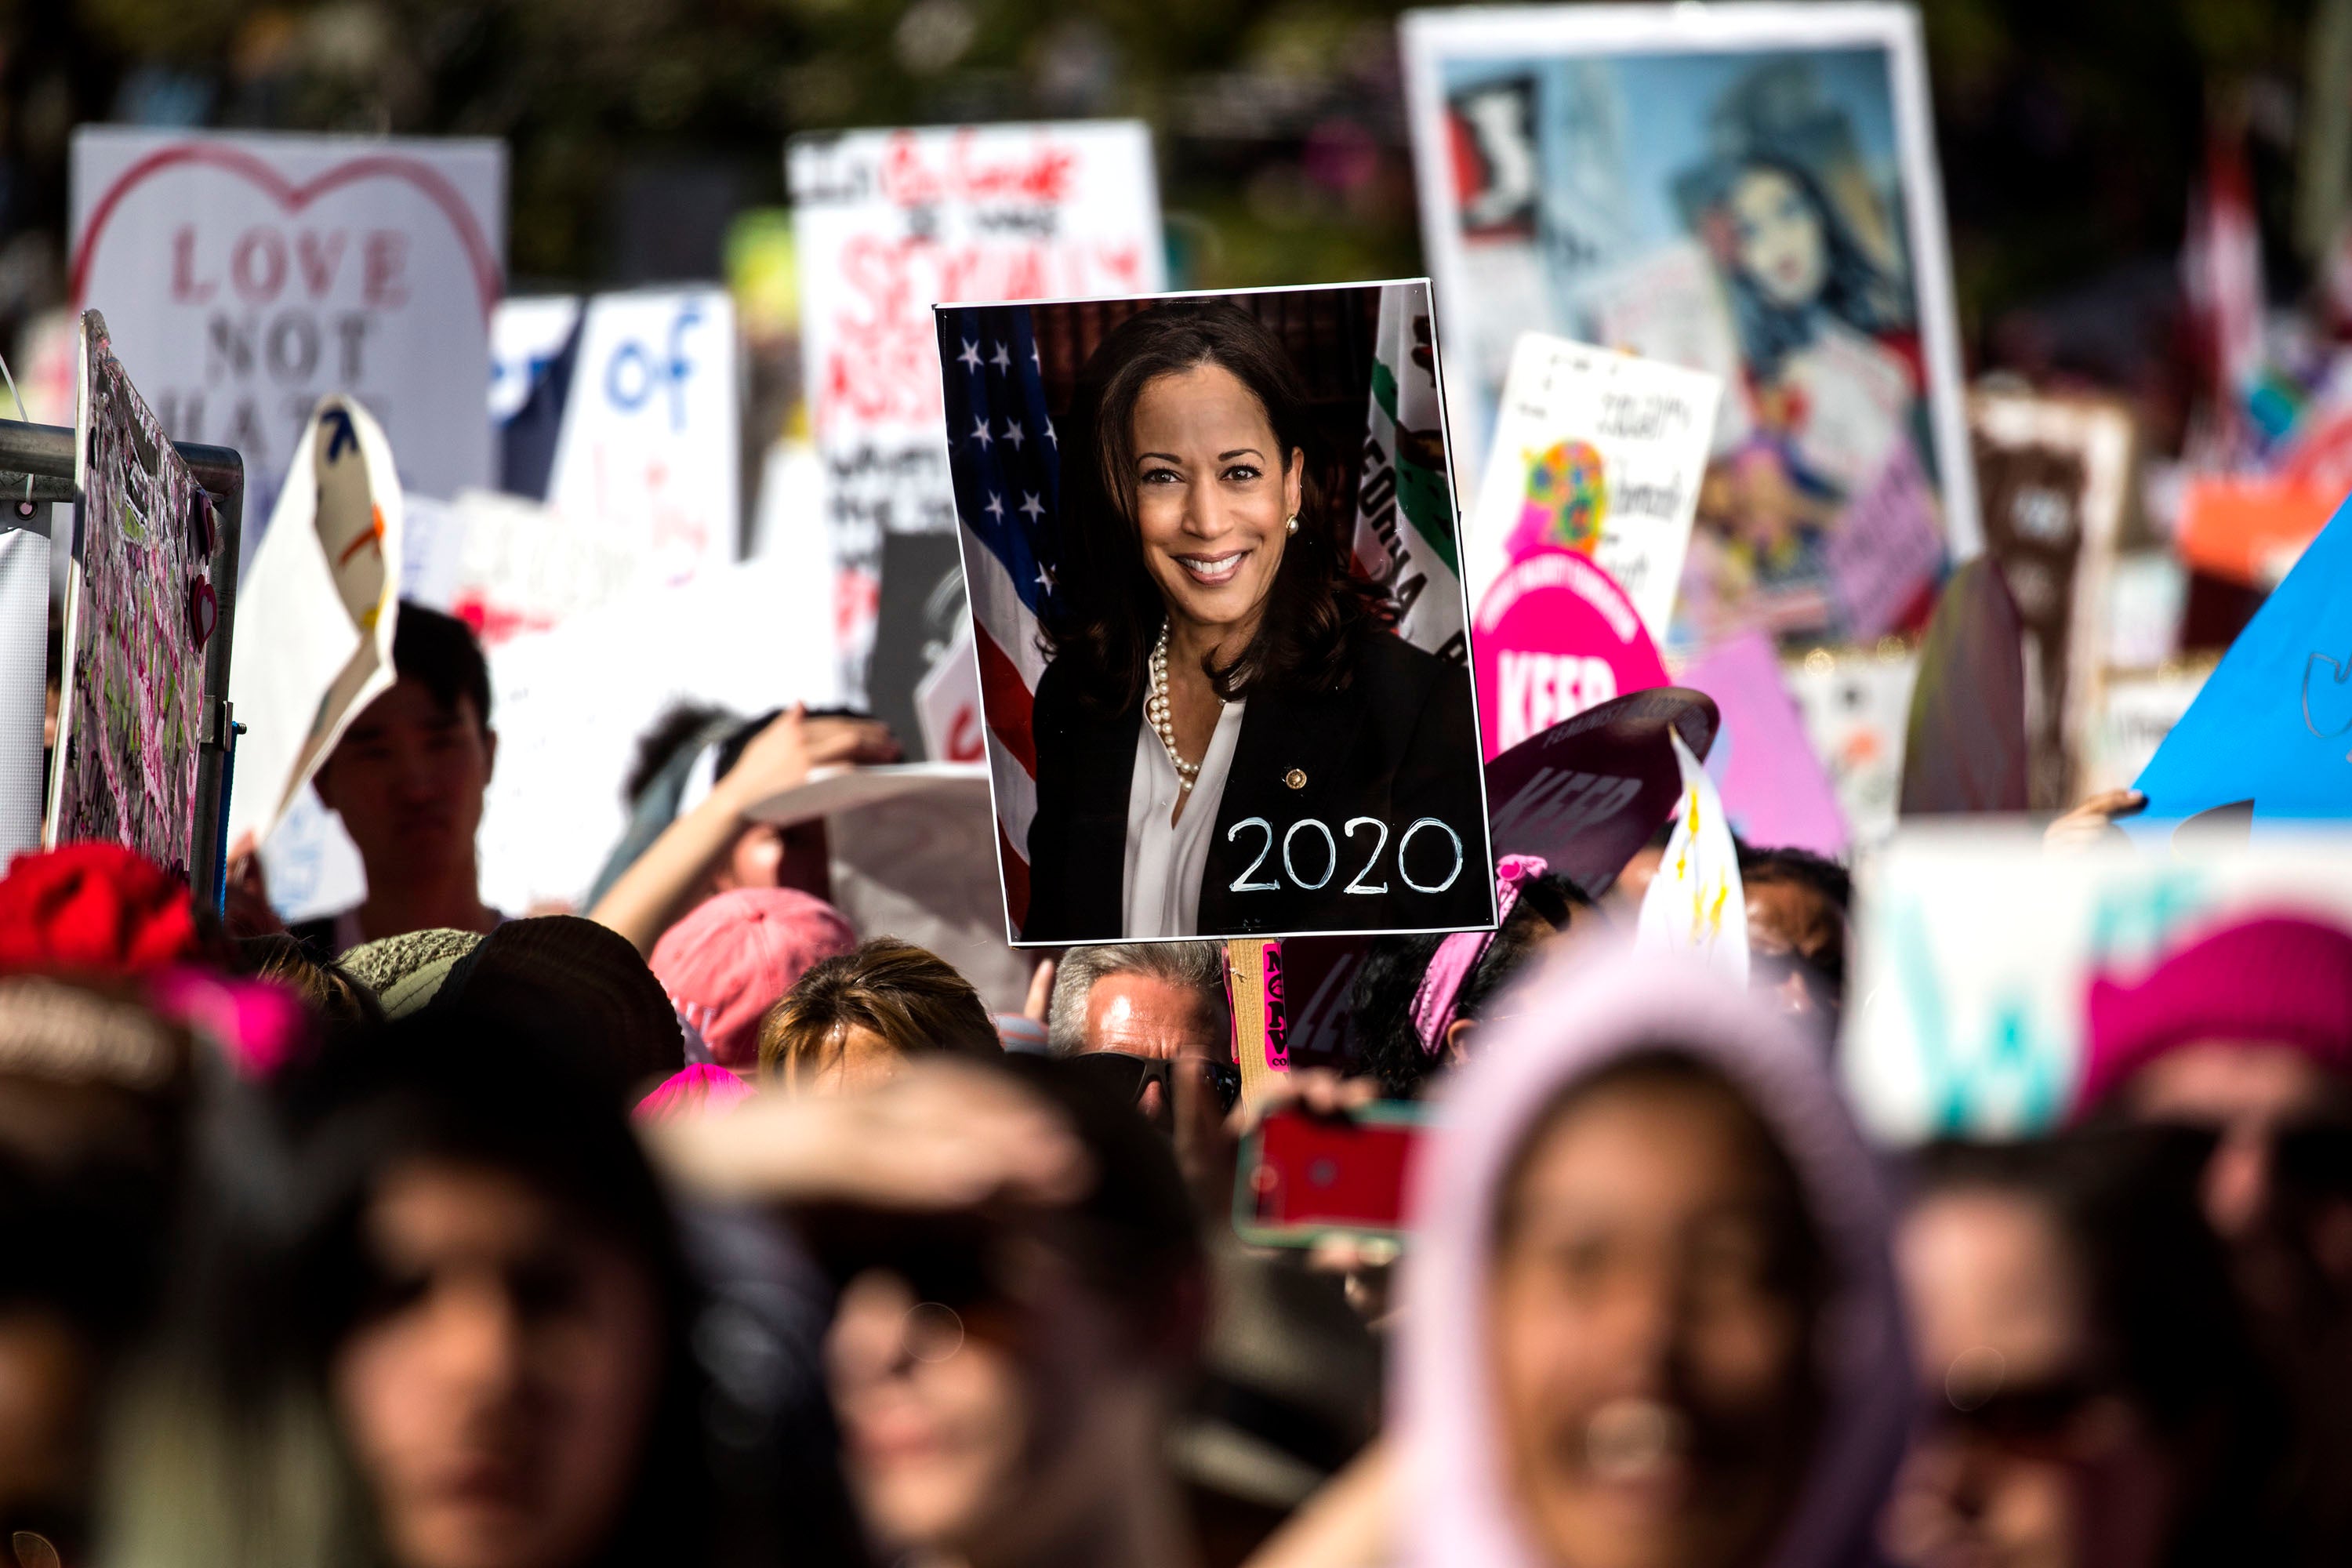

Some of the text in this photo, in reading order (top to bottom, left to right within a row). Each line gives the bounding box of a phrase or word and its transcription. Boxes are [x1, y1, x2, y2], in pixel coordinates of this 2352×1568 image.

[169, 224, 409, 309] LOVE
[207, 309, 369, 386] NOT
[1497, 648, 1618, 754] KEEP
[1491, 766, 1643, 849] KEEP
[1229, 817, 1463, 895] 2020
